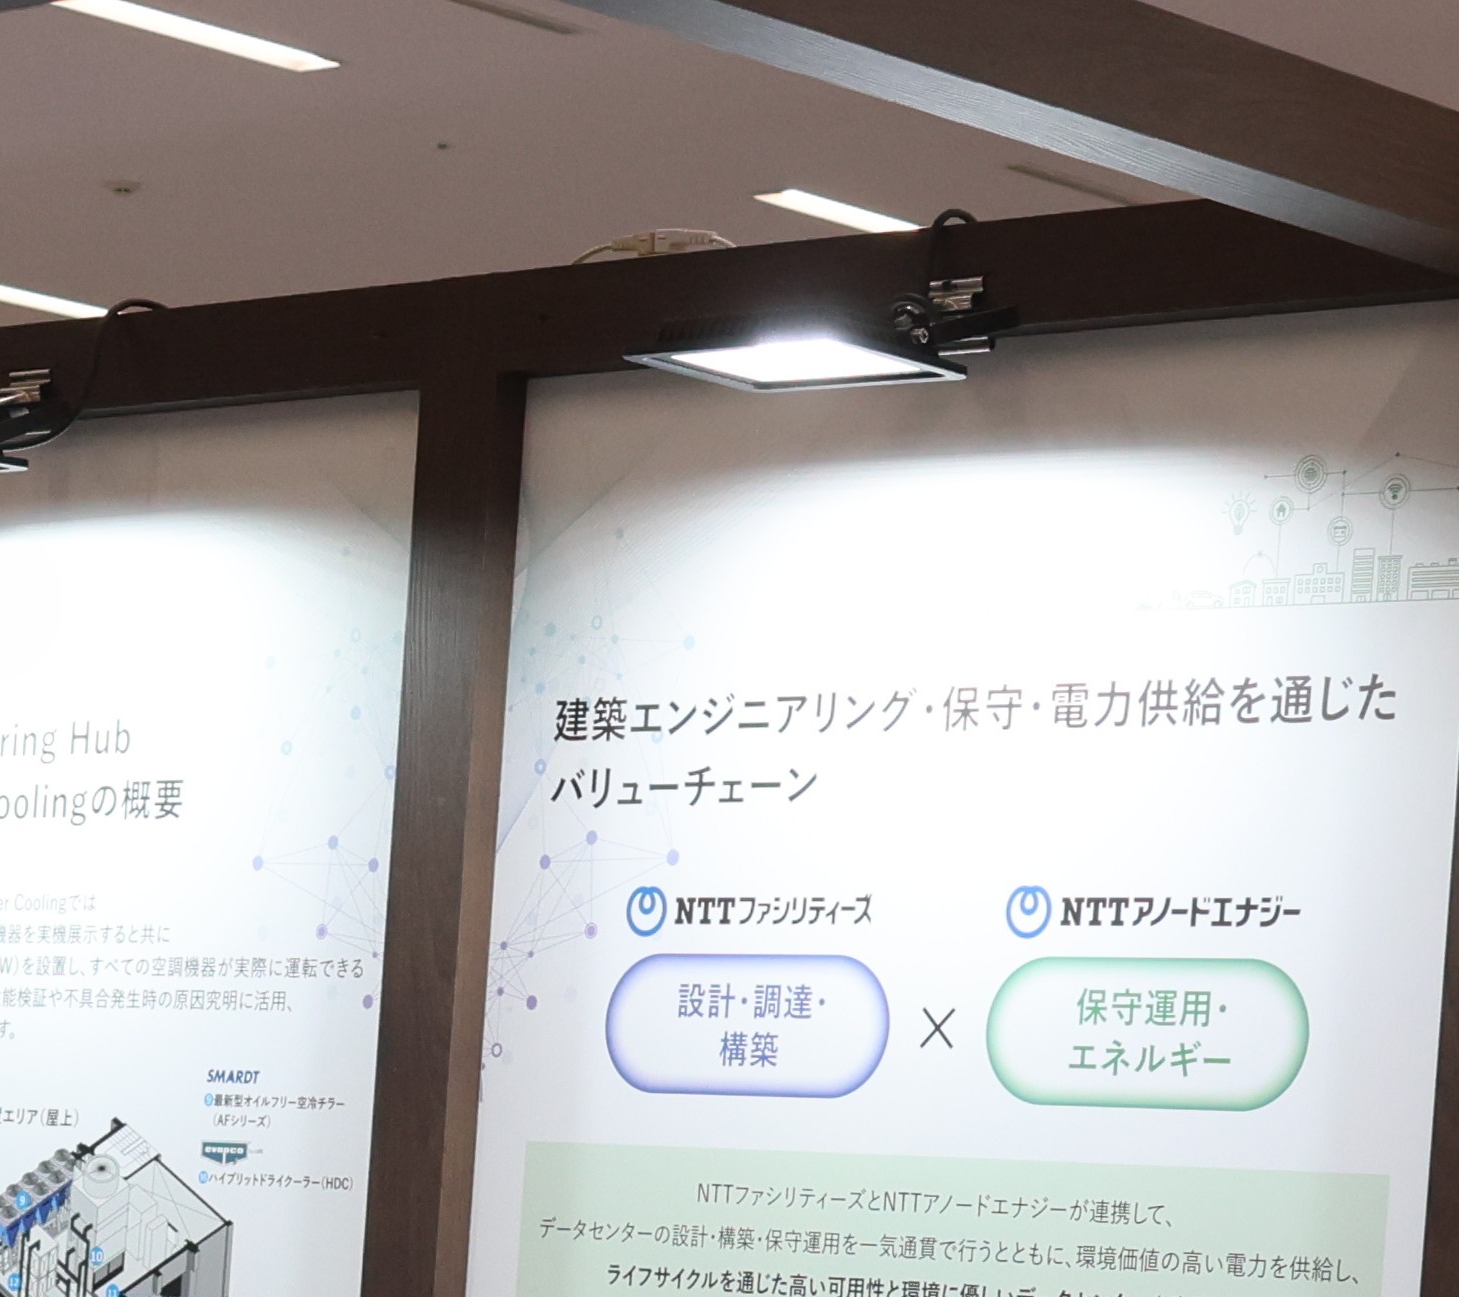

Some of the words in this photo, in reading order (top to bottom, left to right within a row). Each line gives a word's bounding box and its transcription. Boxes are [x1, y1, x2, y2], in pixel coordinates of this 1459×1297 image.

[552, 672, 1398, 743] 建築エンジニアリング・保守・電力供給を通じた
[68, 718, 131, 756] Hub
[550, 765, 818, 809] バリューチェーン
[674, 893, 872, 927] NTTファシリティーズ
[1059, 893, 1302, 929] NTTアノードエナジー
[719, 1031, 779, 1068] 構築
[1067, 1041, 1232, 1078] エネルギー
[206, 1069, 260, 1084] SMARDT
[695, 1181, 1174, 1230] NTTファシリティーズとNTTアノードエナジーが連携して、
